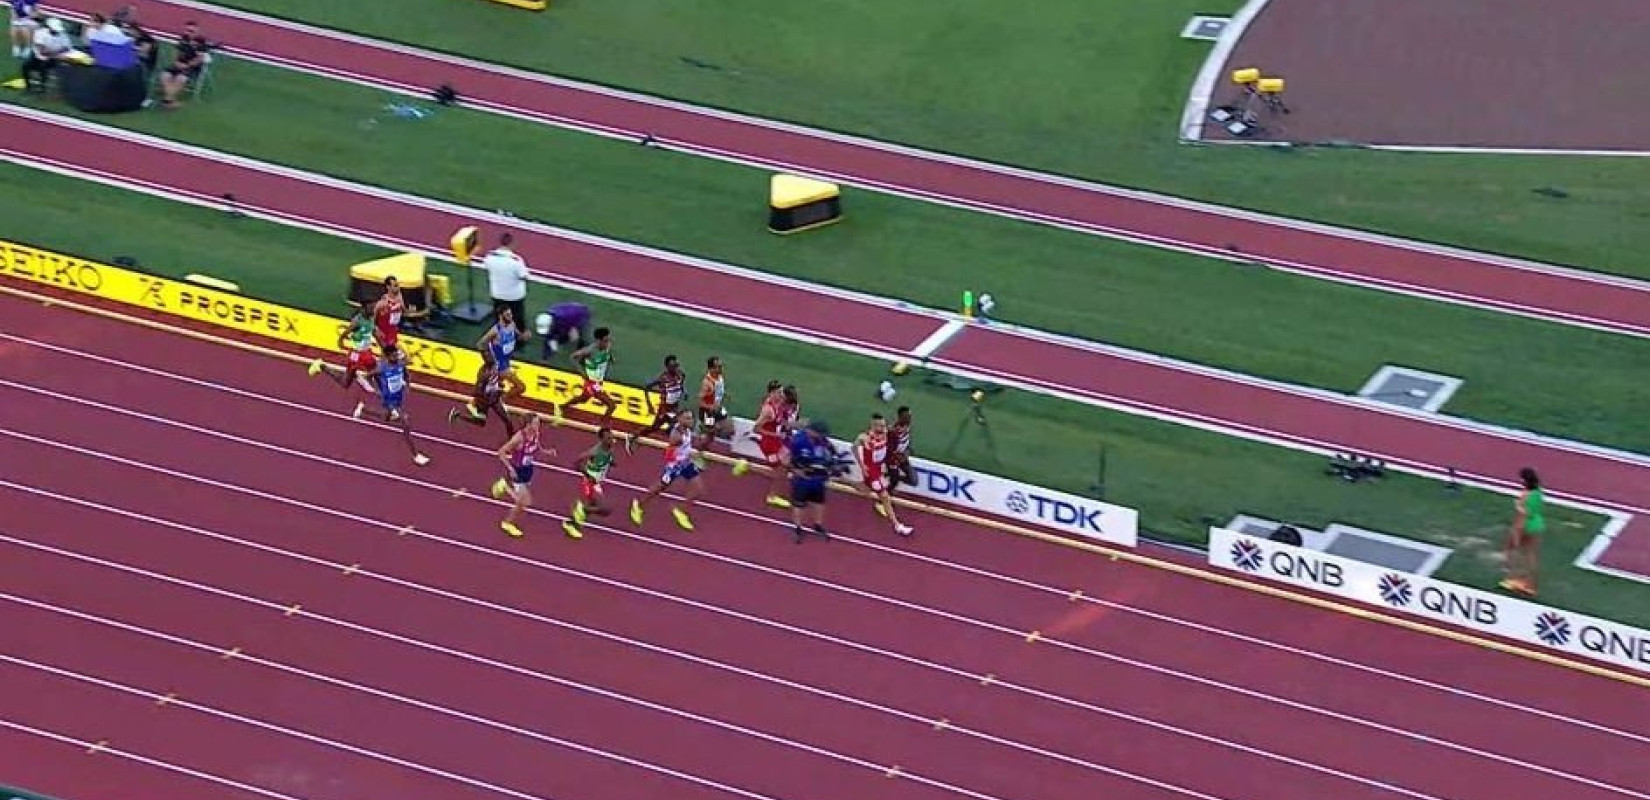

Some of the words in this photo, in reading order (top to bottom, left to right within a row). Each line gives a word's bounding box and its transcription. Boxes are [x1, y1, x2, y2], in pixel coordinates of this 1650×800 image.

[180, 291, 300, 336] PROSPEX
[1029, 494, 1104, 533] TDK
[1271, 551, 1344, 587] QNB
[1420, 586, 1498, 625] QNB
